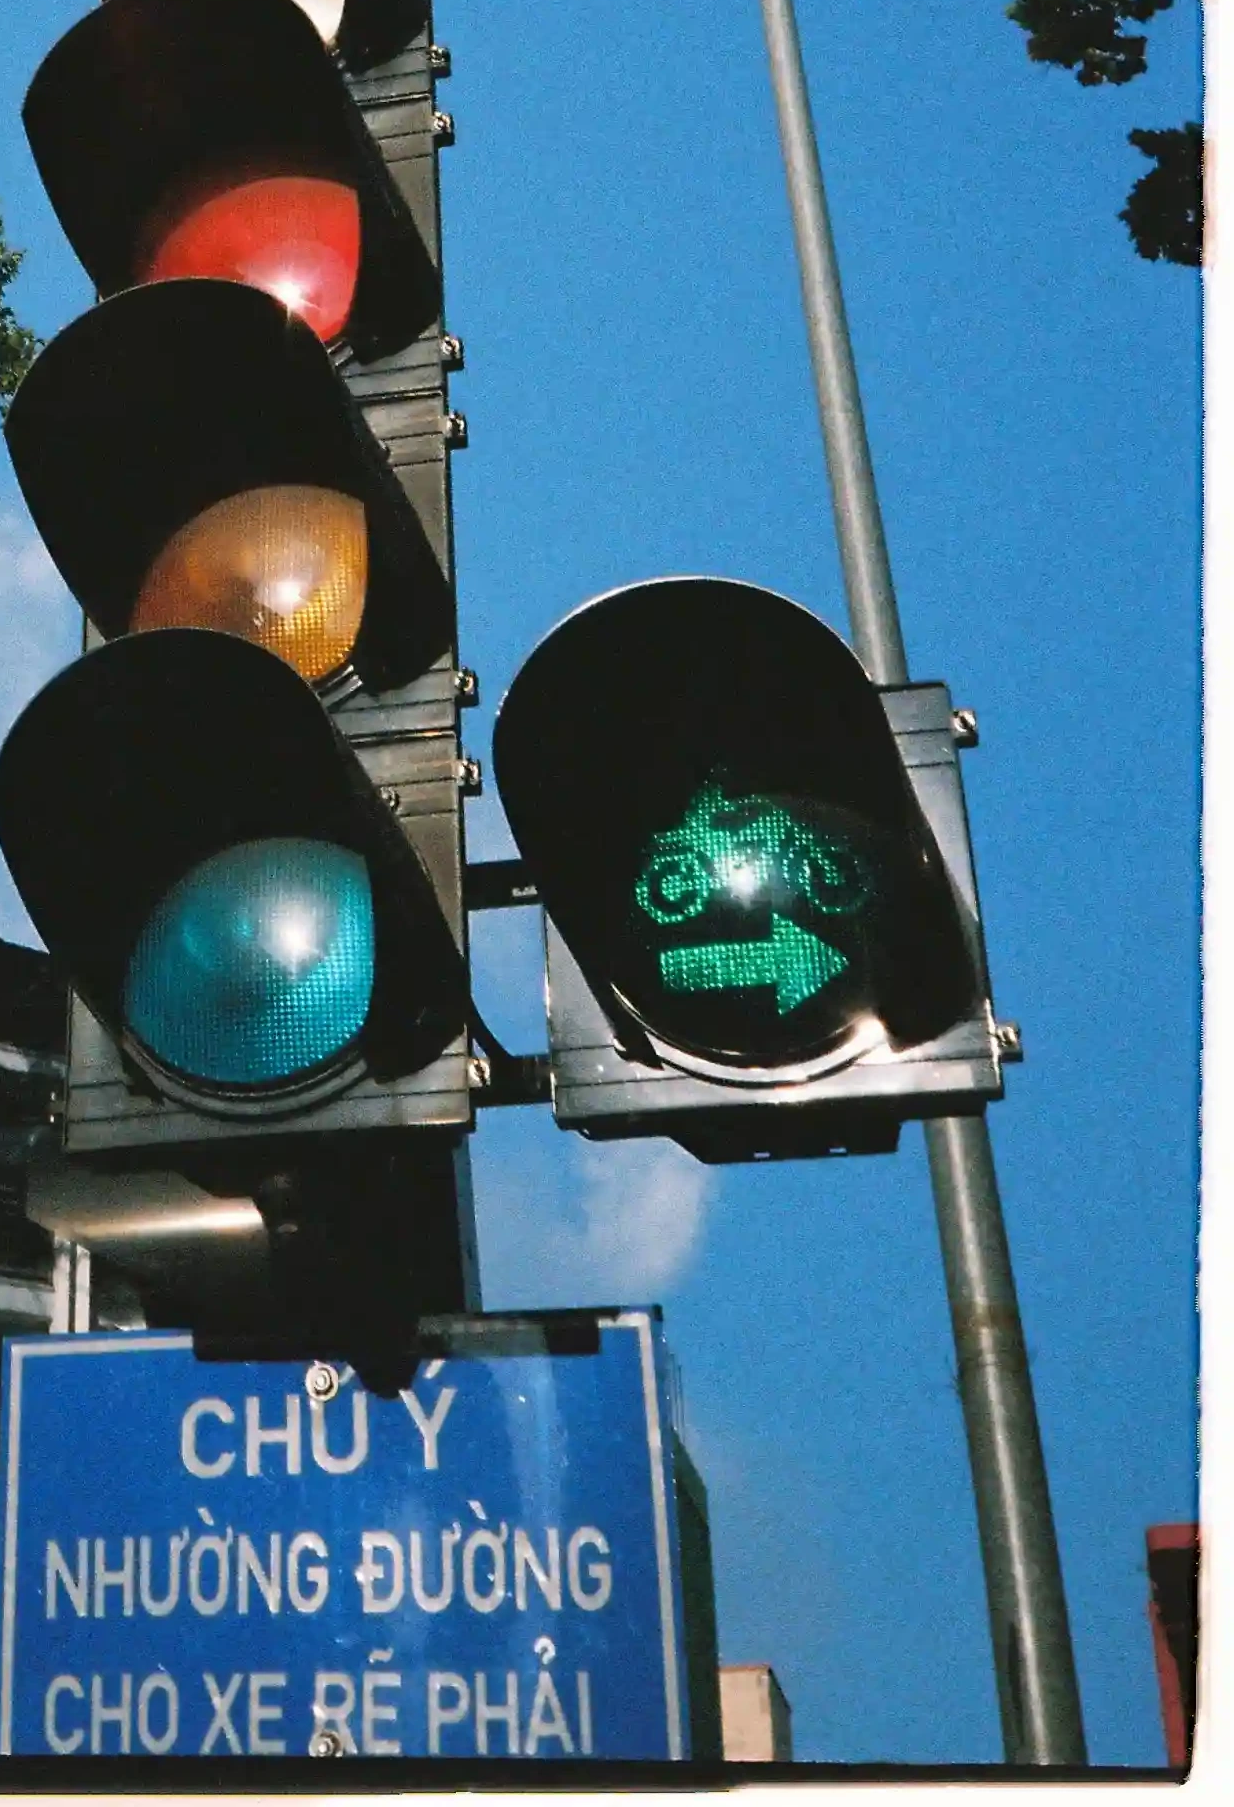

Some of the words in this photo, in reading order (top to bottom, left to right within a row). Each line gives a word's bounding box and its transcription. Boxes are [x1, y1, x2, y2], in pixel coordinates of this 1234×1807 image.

[398, 1359, 459, 1470] Ý
[45, 1506, 329, 1620] NHƯỜNG
[354, 1499, 613, 1614] ĐƯỜNG
[44, 1672, 179, 1755] CHO
[198, 1672, 287, 1755] XE
[310, 1647, 402, 1756] RẼ
[427, 1636, 594, 1755] PHẢI
